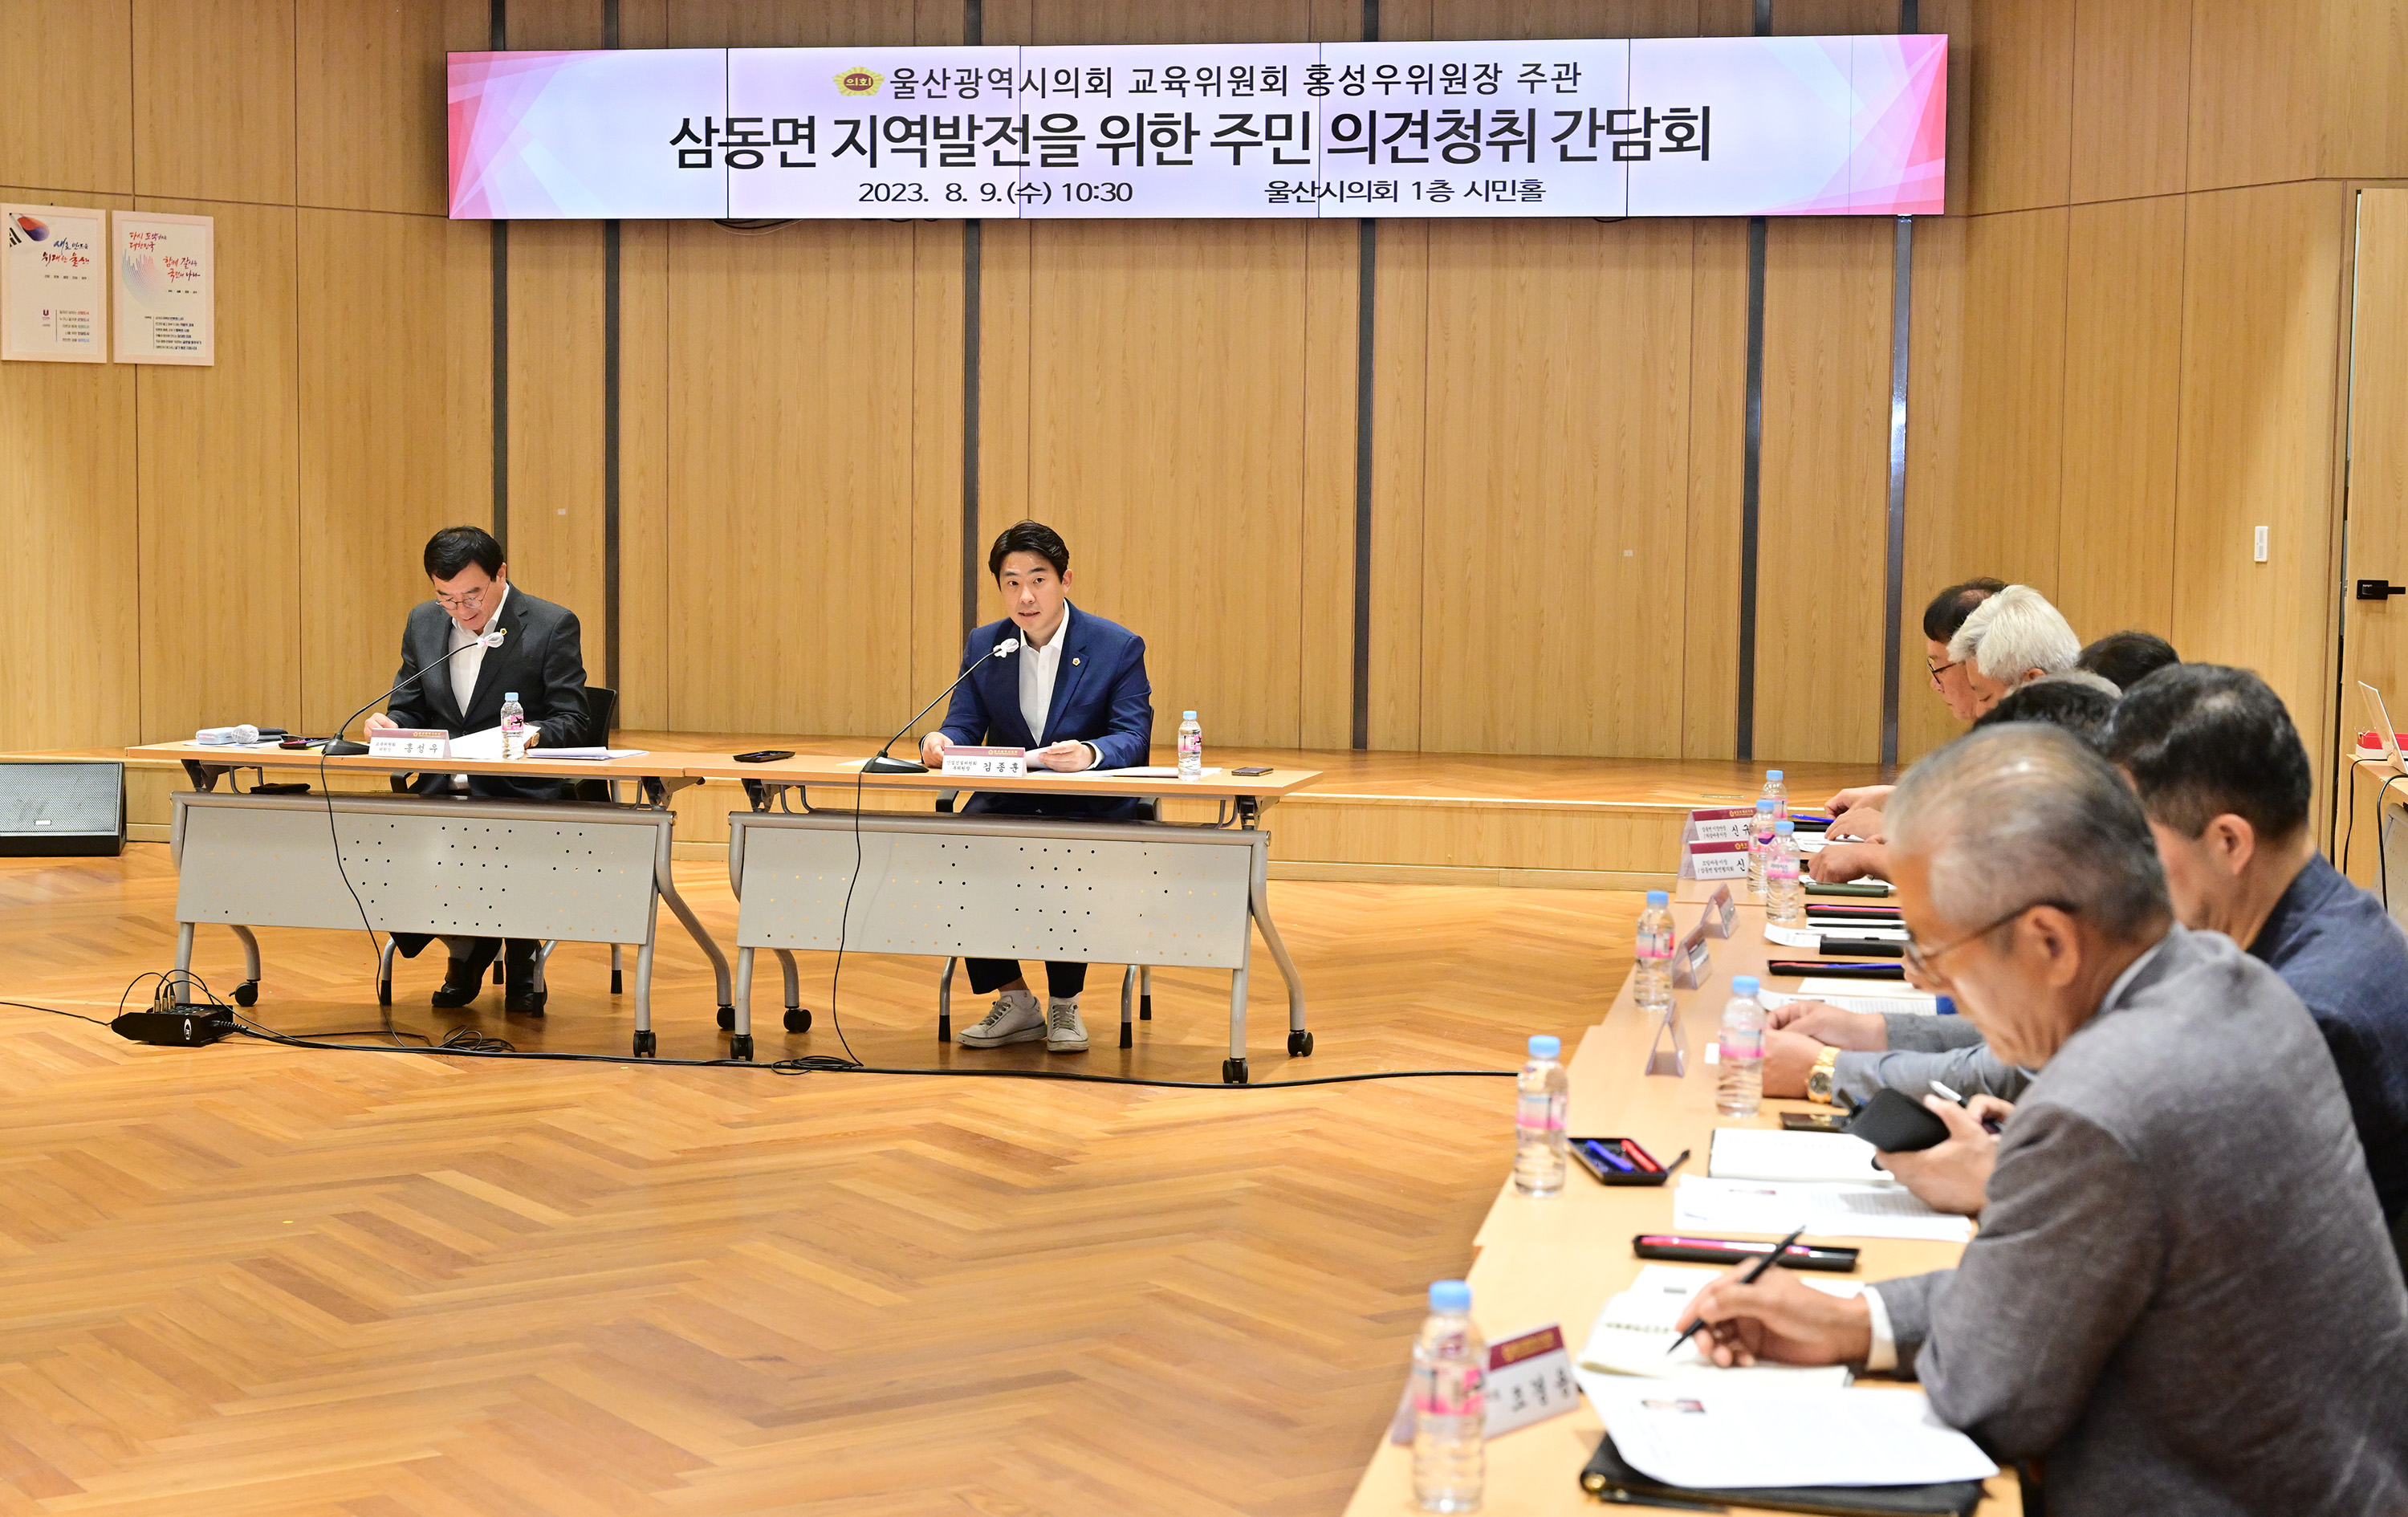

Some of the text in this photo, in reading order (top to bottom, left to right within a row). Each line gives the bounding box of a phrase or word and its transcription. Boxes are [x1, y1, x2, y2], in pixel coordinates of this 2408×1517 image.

[845, 77, 872, 87] 의회
[889, 61, 1583, 100] 울산광역시의회 교육위원회 홍성우위원장 주관
[669, 105, 1710, 170] 삼동면 지역발전을 위한 주민 의견청취 간담회
[858, 182, 929, 203] 2023.
[945, 182, 969, 203] 8.
[1062, 182, 1133, 203] 10:30
[1264, 178, 1547, 204] 울산시의회 1층 시민홀
